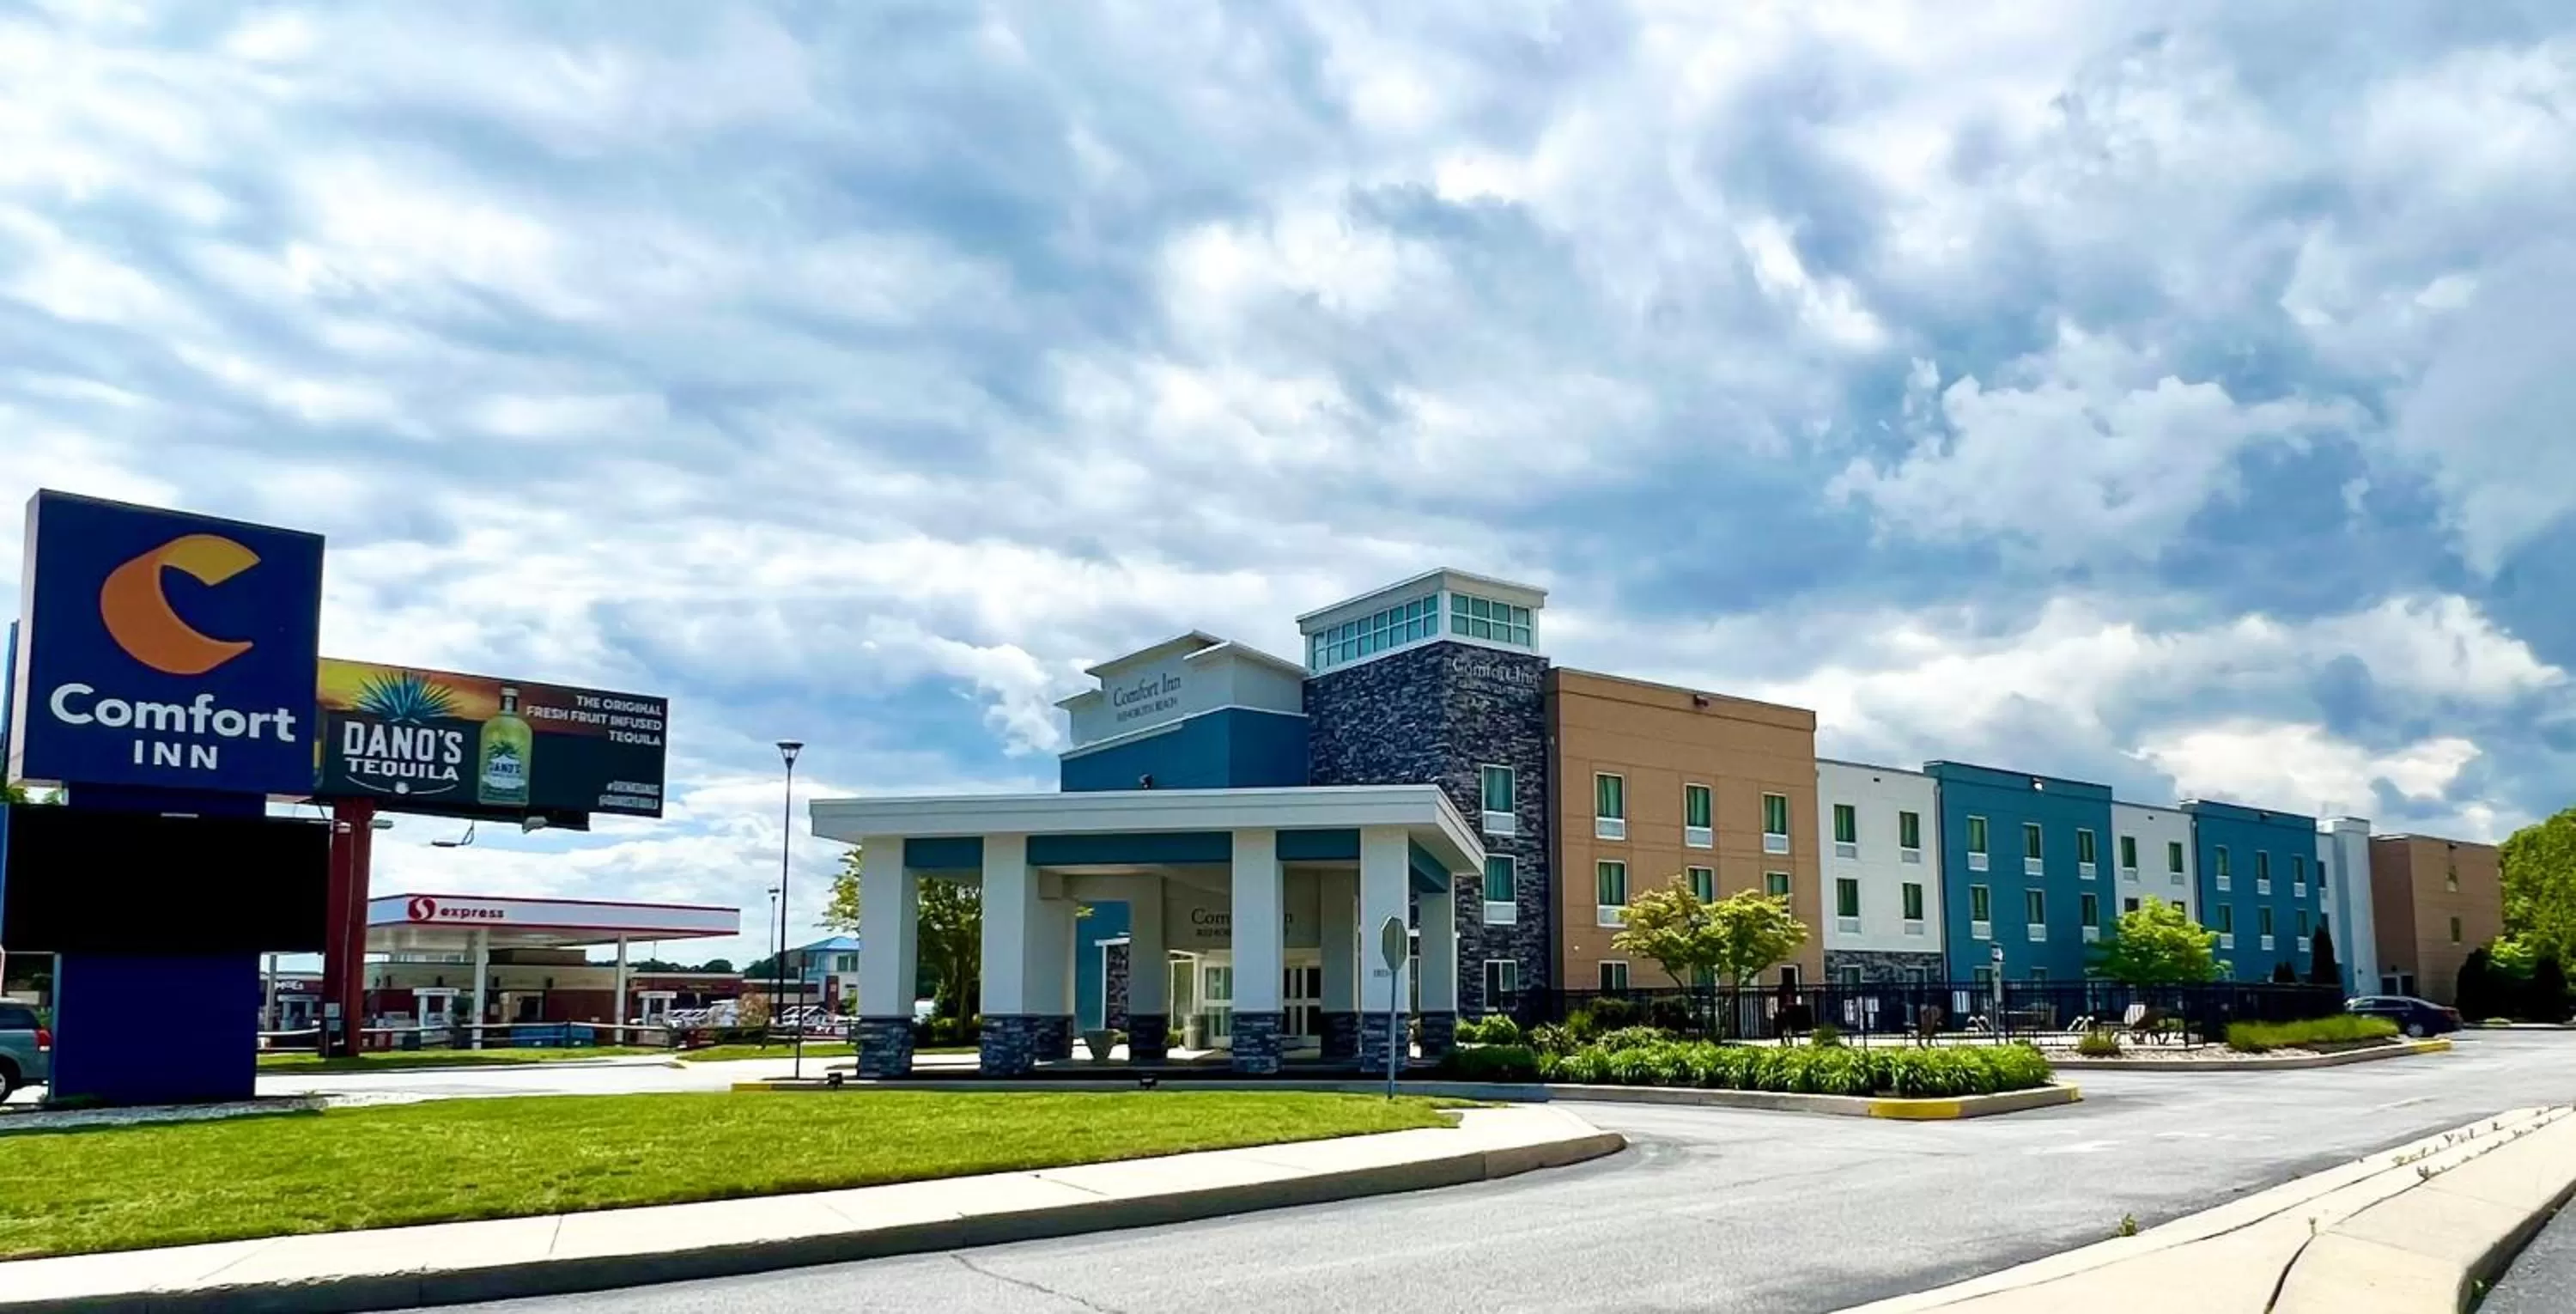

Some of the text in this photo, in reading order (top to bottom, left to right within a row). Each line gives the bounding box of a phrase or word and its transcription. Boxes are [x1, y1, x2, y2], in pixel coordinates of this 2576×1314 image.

[1162, 672, 1182, 693] Inn
[49, 683, 295, 743] Comfort
[576, 695, 662, 715] THE ORIGINAL
[526, 705, 663, 731] FRESH FRUIT INFUSED
[343, 721, 463, 764] DANO'S
[608, 729, 661, 746] TEQUILA
[134, 739, 218, 770] INN
[344, 757, 459, 781] TEQUILA
[440, 906, 504, 919] express
